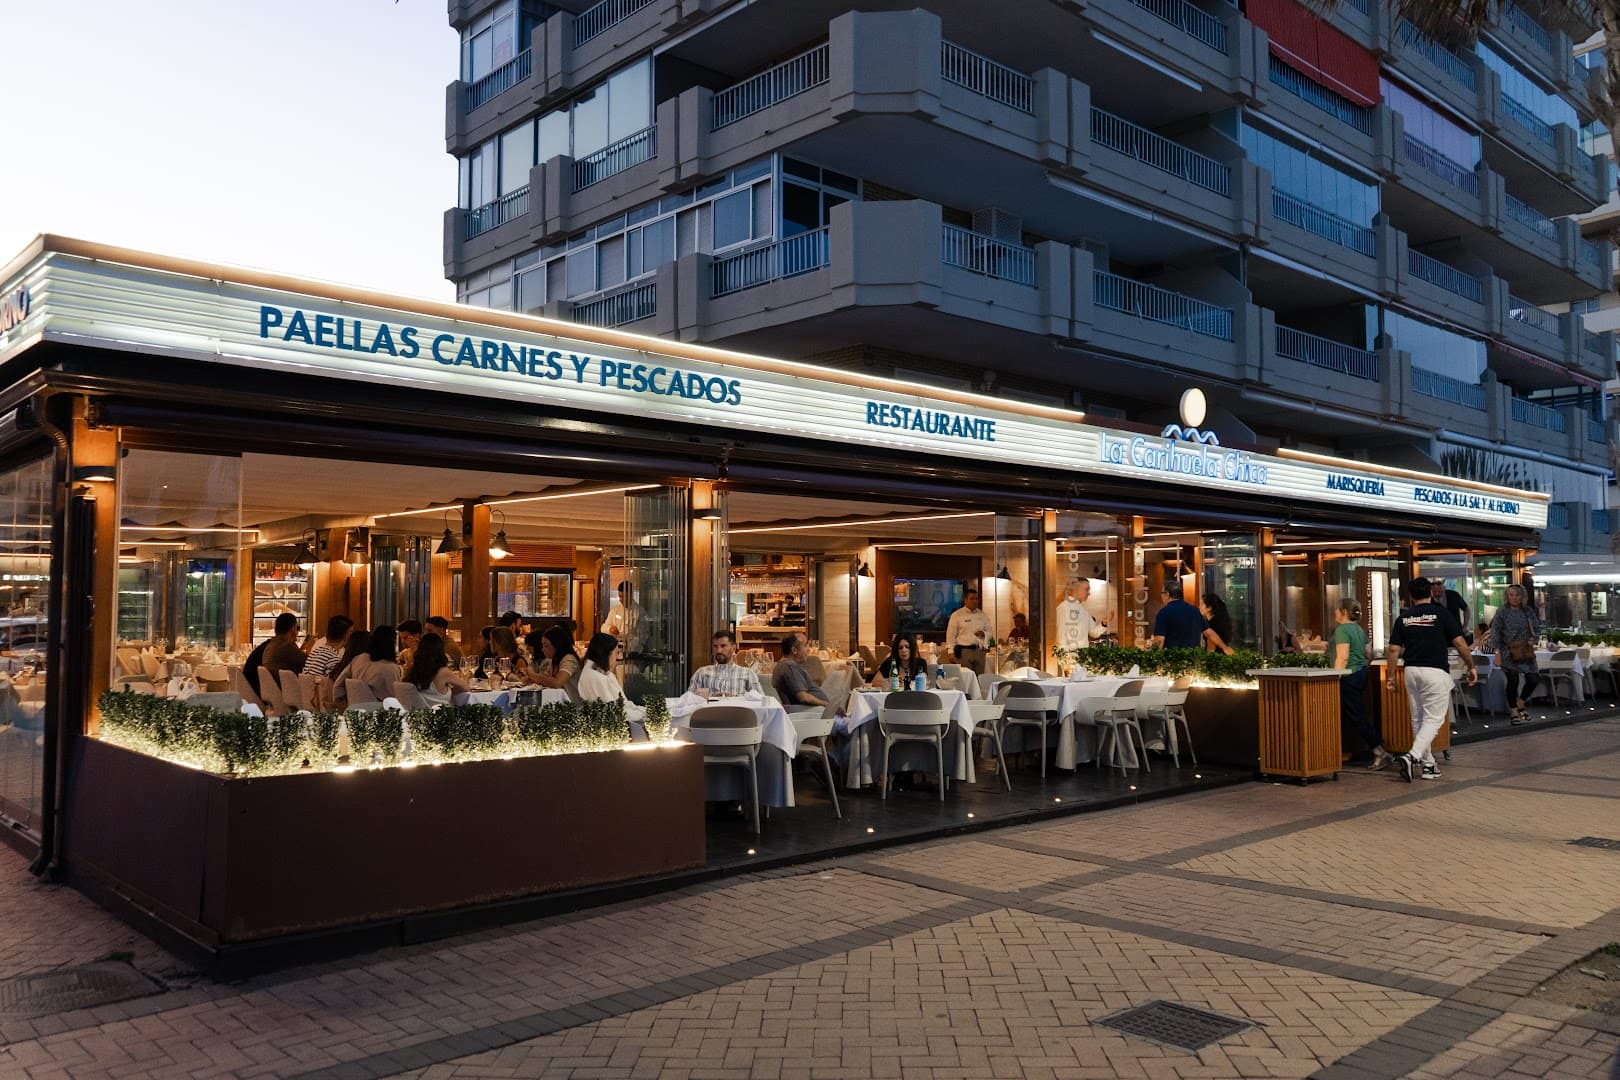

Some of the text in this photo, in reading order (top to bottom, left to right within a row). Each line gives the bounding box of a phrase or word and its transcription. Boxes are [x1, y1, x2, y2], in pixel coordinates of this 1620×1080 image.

[260, 305, 741, 405] PAELLAS CARNES Y PESCADOS
[867, 401, 996, 442] RESTAURANTE
[1100, 432, 1268, 484] La Carihuela Chica
[1414, 487, 1520, 515] PESCADOS A LA SAL Y AL HORNO
